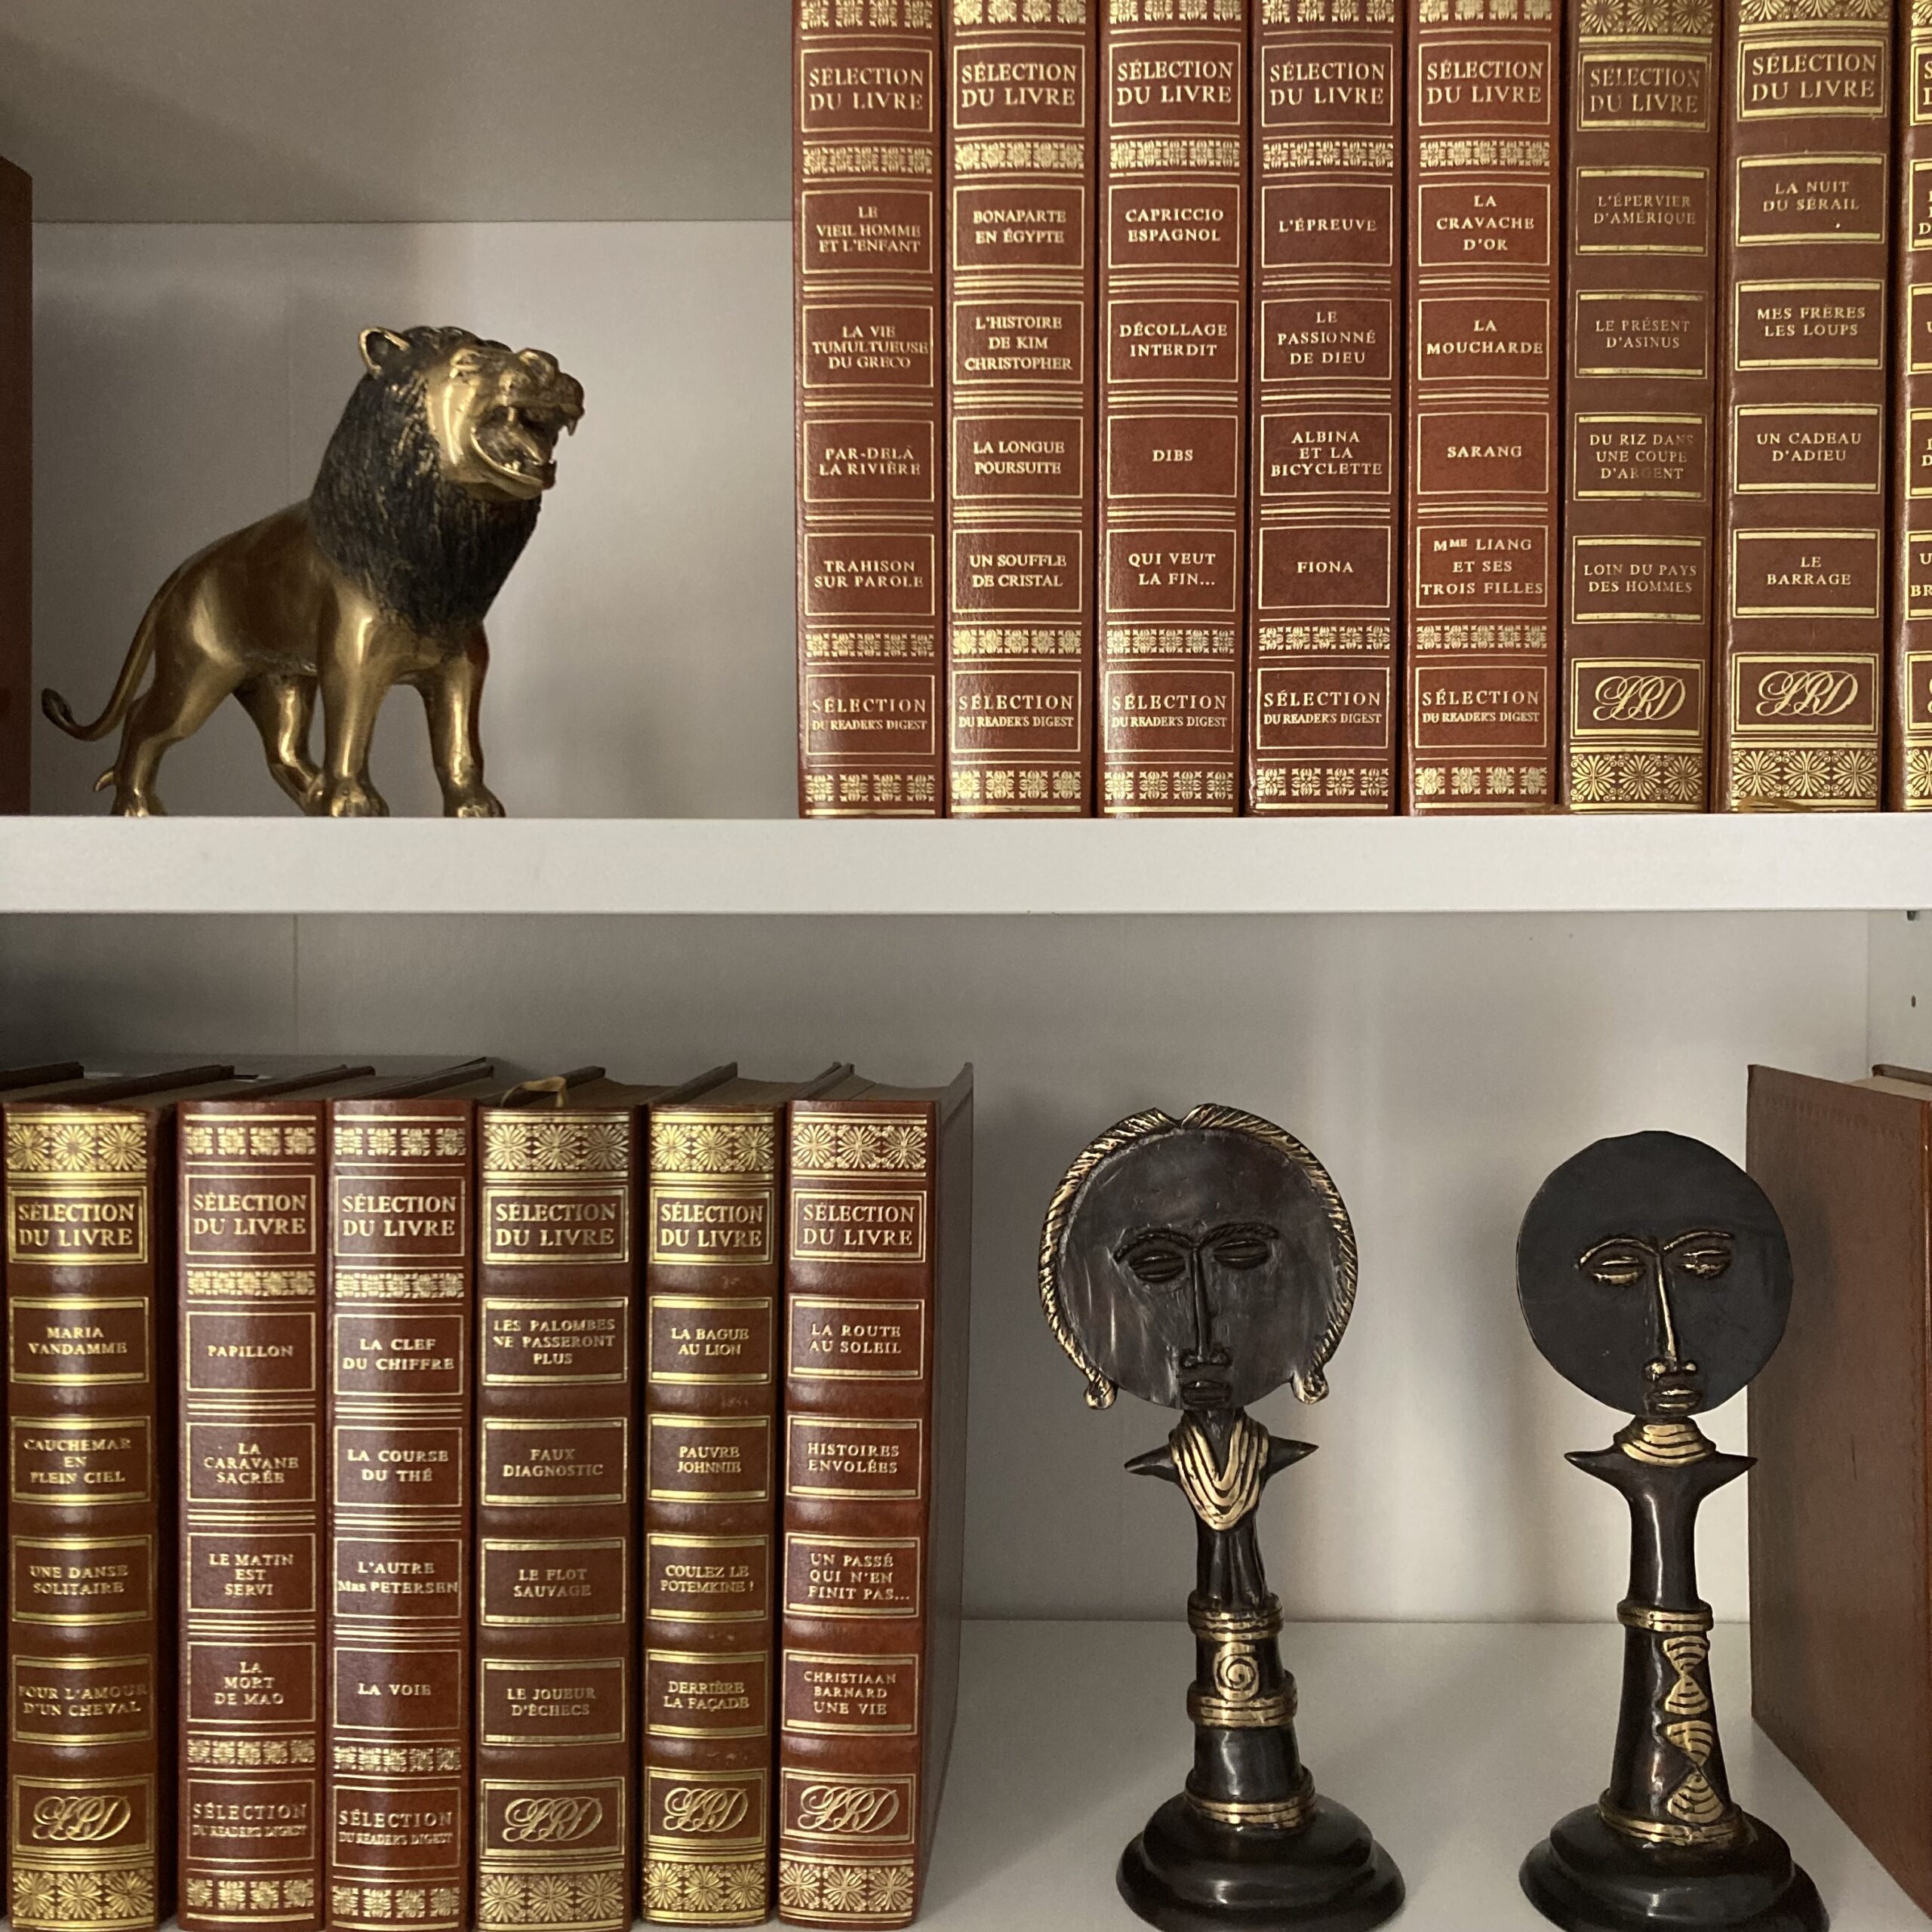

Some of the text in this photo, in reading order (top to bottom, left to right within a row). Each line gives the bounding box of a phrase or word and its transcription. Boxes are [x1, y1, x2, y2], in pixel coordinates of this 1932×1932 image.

[1427, 60, 1543, 81] SÉLECTION
[1752, 53, 1876, 75] SÉLECTION
[1118, 60, 1232, 82] SÉLECTION
[1118, 86, 1231, 106] DU LIVRE
[1427, 86, 1541, 104] DU LIVRE
[1752, 80, 1875, 102] DU LIVRE
[1775, 181, 1850, 195] LA NUIT
[1474, 195, 1497, 208] LA
[1598, 193, 1691, 208] L'ÉPERVIER
[1764, 196, 1860, 212] DU SÉRAIL
[973, 210, 1066, 223] BONAPARTE
[1125, 208, 1223, 222] CAPRICCIO
[1594, 210, 1696, 225] D'AMÉRIQUE
[1278, 217, 1376, 232] L'ÉPREUVE
[1436, 217, 1534, 230] CRAVACHE
[976, 227, 1063, 244] EN ÉGYPTE
[1128, 229, 1220, 242] ESPAGNOL
[1463, 238, 1508, 251] D'OR
[1316, 312, 1337, 323] LE
[1758, 307, 1792, 319] MES
[976, 316, 1062, 330] L'HISTOIRE
[1120, 321, 1227, 337] DÉCOLLAGE
[1474, 320, 1497, 332] LA
[1595, 316, 1690, 332] LE PRÉSENT
[1764, 324, 1858, 337] LES LOUPS
[989, 337, 1048, 349] DE KIM
[1278, 330, 1376, 346] PASSIONNÉ
[1607, 335, 1680, 349] D'ASINUS
[1131, 343, 1217, 357] INTERDIT
[1426, 341, 1543, 355] MOUCHARDE
[964, 358, 1072, 371] CHRISTOPHER
[1290, 351, 1365, 365] DE DIEU
[1292, 431, 1360, 444] ALBINA
[1590, 434, 1611, 446] DU
[1620, 434, 1646, 446] RIZ
[1758, 432, 1861, 445] UN CADEAU
[973, 441, 1064, 454] LA LONGUE
[1300, 447, 1353, 460] ET LA
[1447, 446, 1522, 459] SARANG
[1152, 449, 1192, 462] DIBS
[1596, 451, 1687, 463] UNE COUPE
[1773, 449, 1847, 462] D'ADIEU
[974, 462, 1061, 474] POURSUITE
[1271, 463, 1383, 476] BICYCLETTE
[1476, 539, 1532, 551] LIANG
[824, 560, 915, 573] TRAHISON
[971, 555, 1066, 567] UN SOUFFLE
[1129, 553, 1215, 567] QUI VEUT
[1453, 560, 1512, 573] ET SES
[1801, 556, 1822, 568] LE
[1297, 561, 1353, 574] FIONA
[1584, 565, 1697, 577] LOIN DU PAYS
[814, 575, 923, 588] SUR PAROLE
[972, 574, 1063, 587] DE CRISTAL
[1138, 574, 1161, 586] LA
[1767, 573, 1851, 586] BARRAGE
[1421, 583, 1543, 595] TROIS FILLES
[1589, 581, 1692, 593] DES HOMMES
[1112, 692, 1226, 709] SÉLECTION
[1422, 688, 1539, 706] SÉLECTION
[661, 1201, 763, 1223] SÉLECTION
[803, 1203, 914, 1223] SÉLECTION
[661, 1229, 761, 1247] DU LIVRE
[803, 1229, 912, 1245] DU LIVRE
[494, 1318, 615, 1331] LES PALOMBES
[811, 1324, 900, 1337] LA ROUTE
[47, 1327, 104, 1339] MARIA
[671, 1327, 749, 1340] LA BAGUE
[360, 1339, 436, 1351] LA CLEF
[522, 1335, 614, 1348] PASSERONT
[809, 1340, 900, 1354] AU SOLEIL
[29, 1343, 127, 1355] VANDAMME
[208, 1346, 293, 1358] PAPILLON
[678, 1343, 741, 1355] AU LION
[343, 1358, 454, 1370] DU CHIFFRE
[534, 1352, 573, 1364] PLUS
[24, 1438, 131, 1452] CAUCHEMAR
[680, 1446, 740, 1457] PAUVRE
[808, 1443, 899, 1457] HISTOIRES
[347, 1449, 448, 1463] LA COURSE
[531, 1448, 575, 1461] FAUX
[63, 1457, 87, 1467] EN
[678, 1461, 741, 1473] JOHNNIE
[808, 1457, 897, 1473] ENVOLÉES
[30, 1471, 125, 1484] PLEIN CIEL
[362, 1467, 432, 1482] DU THÉ
[503, 1464, 603, 1478] DIAGNOSTIC
[209, 1555, 294, 1566] LE MATIN
[811, 1552, 893, 1567] UN PASSÉ
[235, 1570, 266, 1581] EST
[518, 1568, 587, 1580] LE FLOT
[810, 1570, 892, 1583] QUI N'EN
[225, 1584, 273, 1595] SERVI
[513, 1584, 591, 1597] SAUVAGE
[808, 1587, 858, 1600] FINIT
[240, 1663, 261, 1673] LA
[224, 1677, 275, 1689] MORT
[804, 1672, 896, 1684] CHRISTIAAN
[358, 1683, 431, 1696] LA VOIE
[814, 1686, 887, 1698] BARNARD
[214, 1693, 284, 1705] DE MAO
[663, 1695, 749, 1711] LA FAÇADE
[814, 1701, 887, 1715] UNE VIE
